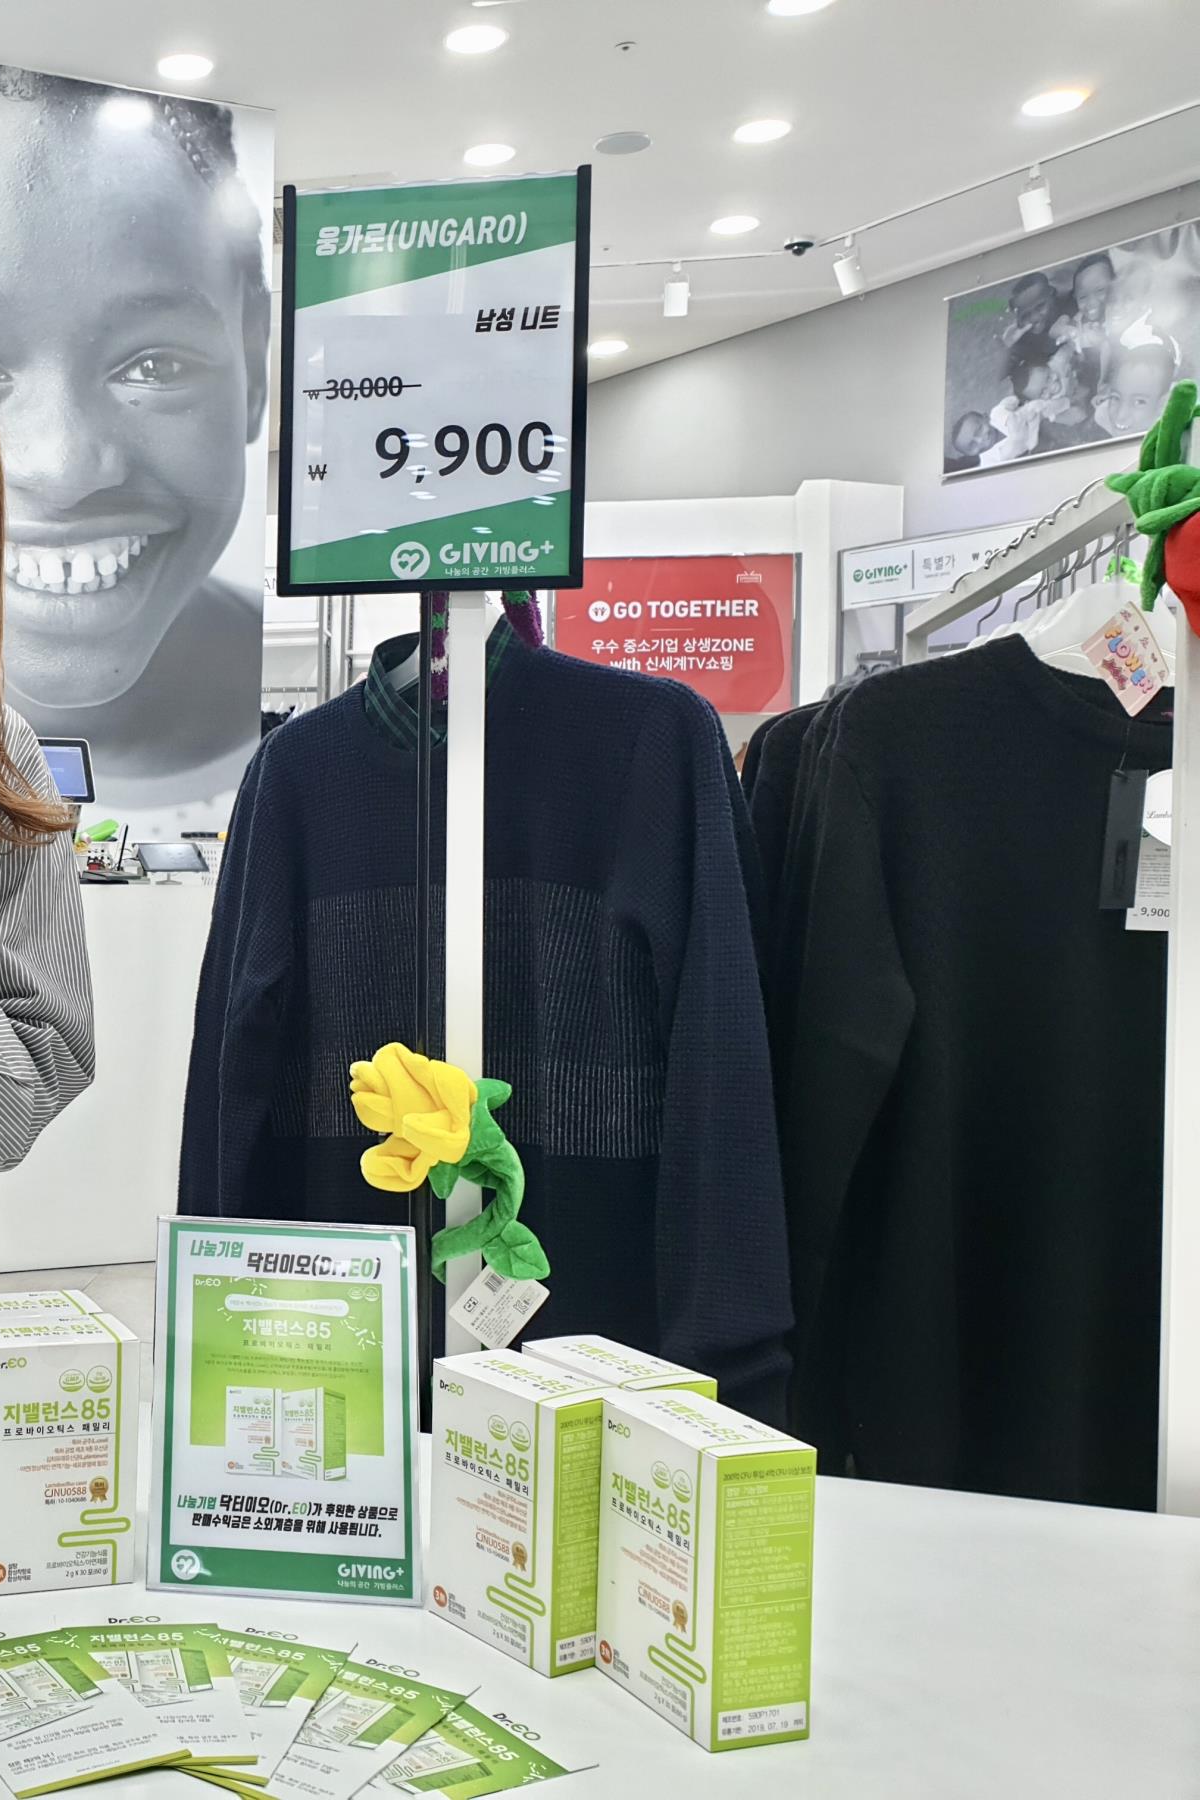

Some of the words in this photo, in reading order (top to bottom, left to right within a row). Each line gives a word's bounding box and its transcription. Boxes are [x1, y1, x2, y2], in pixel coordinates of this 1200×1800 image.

[315, 211, 528, 256] 웅가로(UNGARO)
[475, 307, 515, 333] 남성
[520, 305, 561, 330] 니트
[325, 376, 403, 401] 30,000
[375, 421, 555, 484] 9,900
[439, 540, 554, 565] GIVING+
[922, 554, 955, 571] 특별가
[472, 567, 489, 575] 공간
[494, 565, 536, 574] 기빙플러스
[614, 601, 641, 618] GO
[647, 600, 758, 618] TOGETHER
[592, 640, 619, 654] 우수
[623, 639, 678, 653] 중소기업
[683, 638, 754, 653] 상생ZONE
[610, 657, 640, 671] with
[646, 656, 733, 672] 신세계TV쇼핑
[190, 1239, 243, 1258] 나눔기업
[242, 1318, 332, 1339] 지밸런스85
[3, 1398, 110, 1424] 지밸런스85
[3, 1425, 75, 1437] 프로바이오틱스
[82, 1422, 110, 1431] 패밀리
[445, 1429, 530, 1482] 지밸런스85
[445, 1452, 500, 1482] 프로바이오틱스
[506, 1478, 529, 1496] 패밀리
[44, 1487, 87, 1498] CJNU0588
[612, 1472, 690, 1536] 지밸런스85
[177, 1494, 217, 1510] 나눔기업
[219, 1494, 322, 1516] 닥터이오(Dr.EO)가
[325, 1503, 356, 1519] 후원한
[358, 1506, 398, 1521] 상품으로
[192, 1513, 251, 1530] 판매수익금은
[253, 1517, 304, 1533] 소외계층을
[306, 1520, 326, 1534] 위해
[328, 1521, 382, 1538] 사용됩니다.
[337, 1563, 405, 1581] GIVING+
[90, 1632, 184, 1643] 지밸런스85
